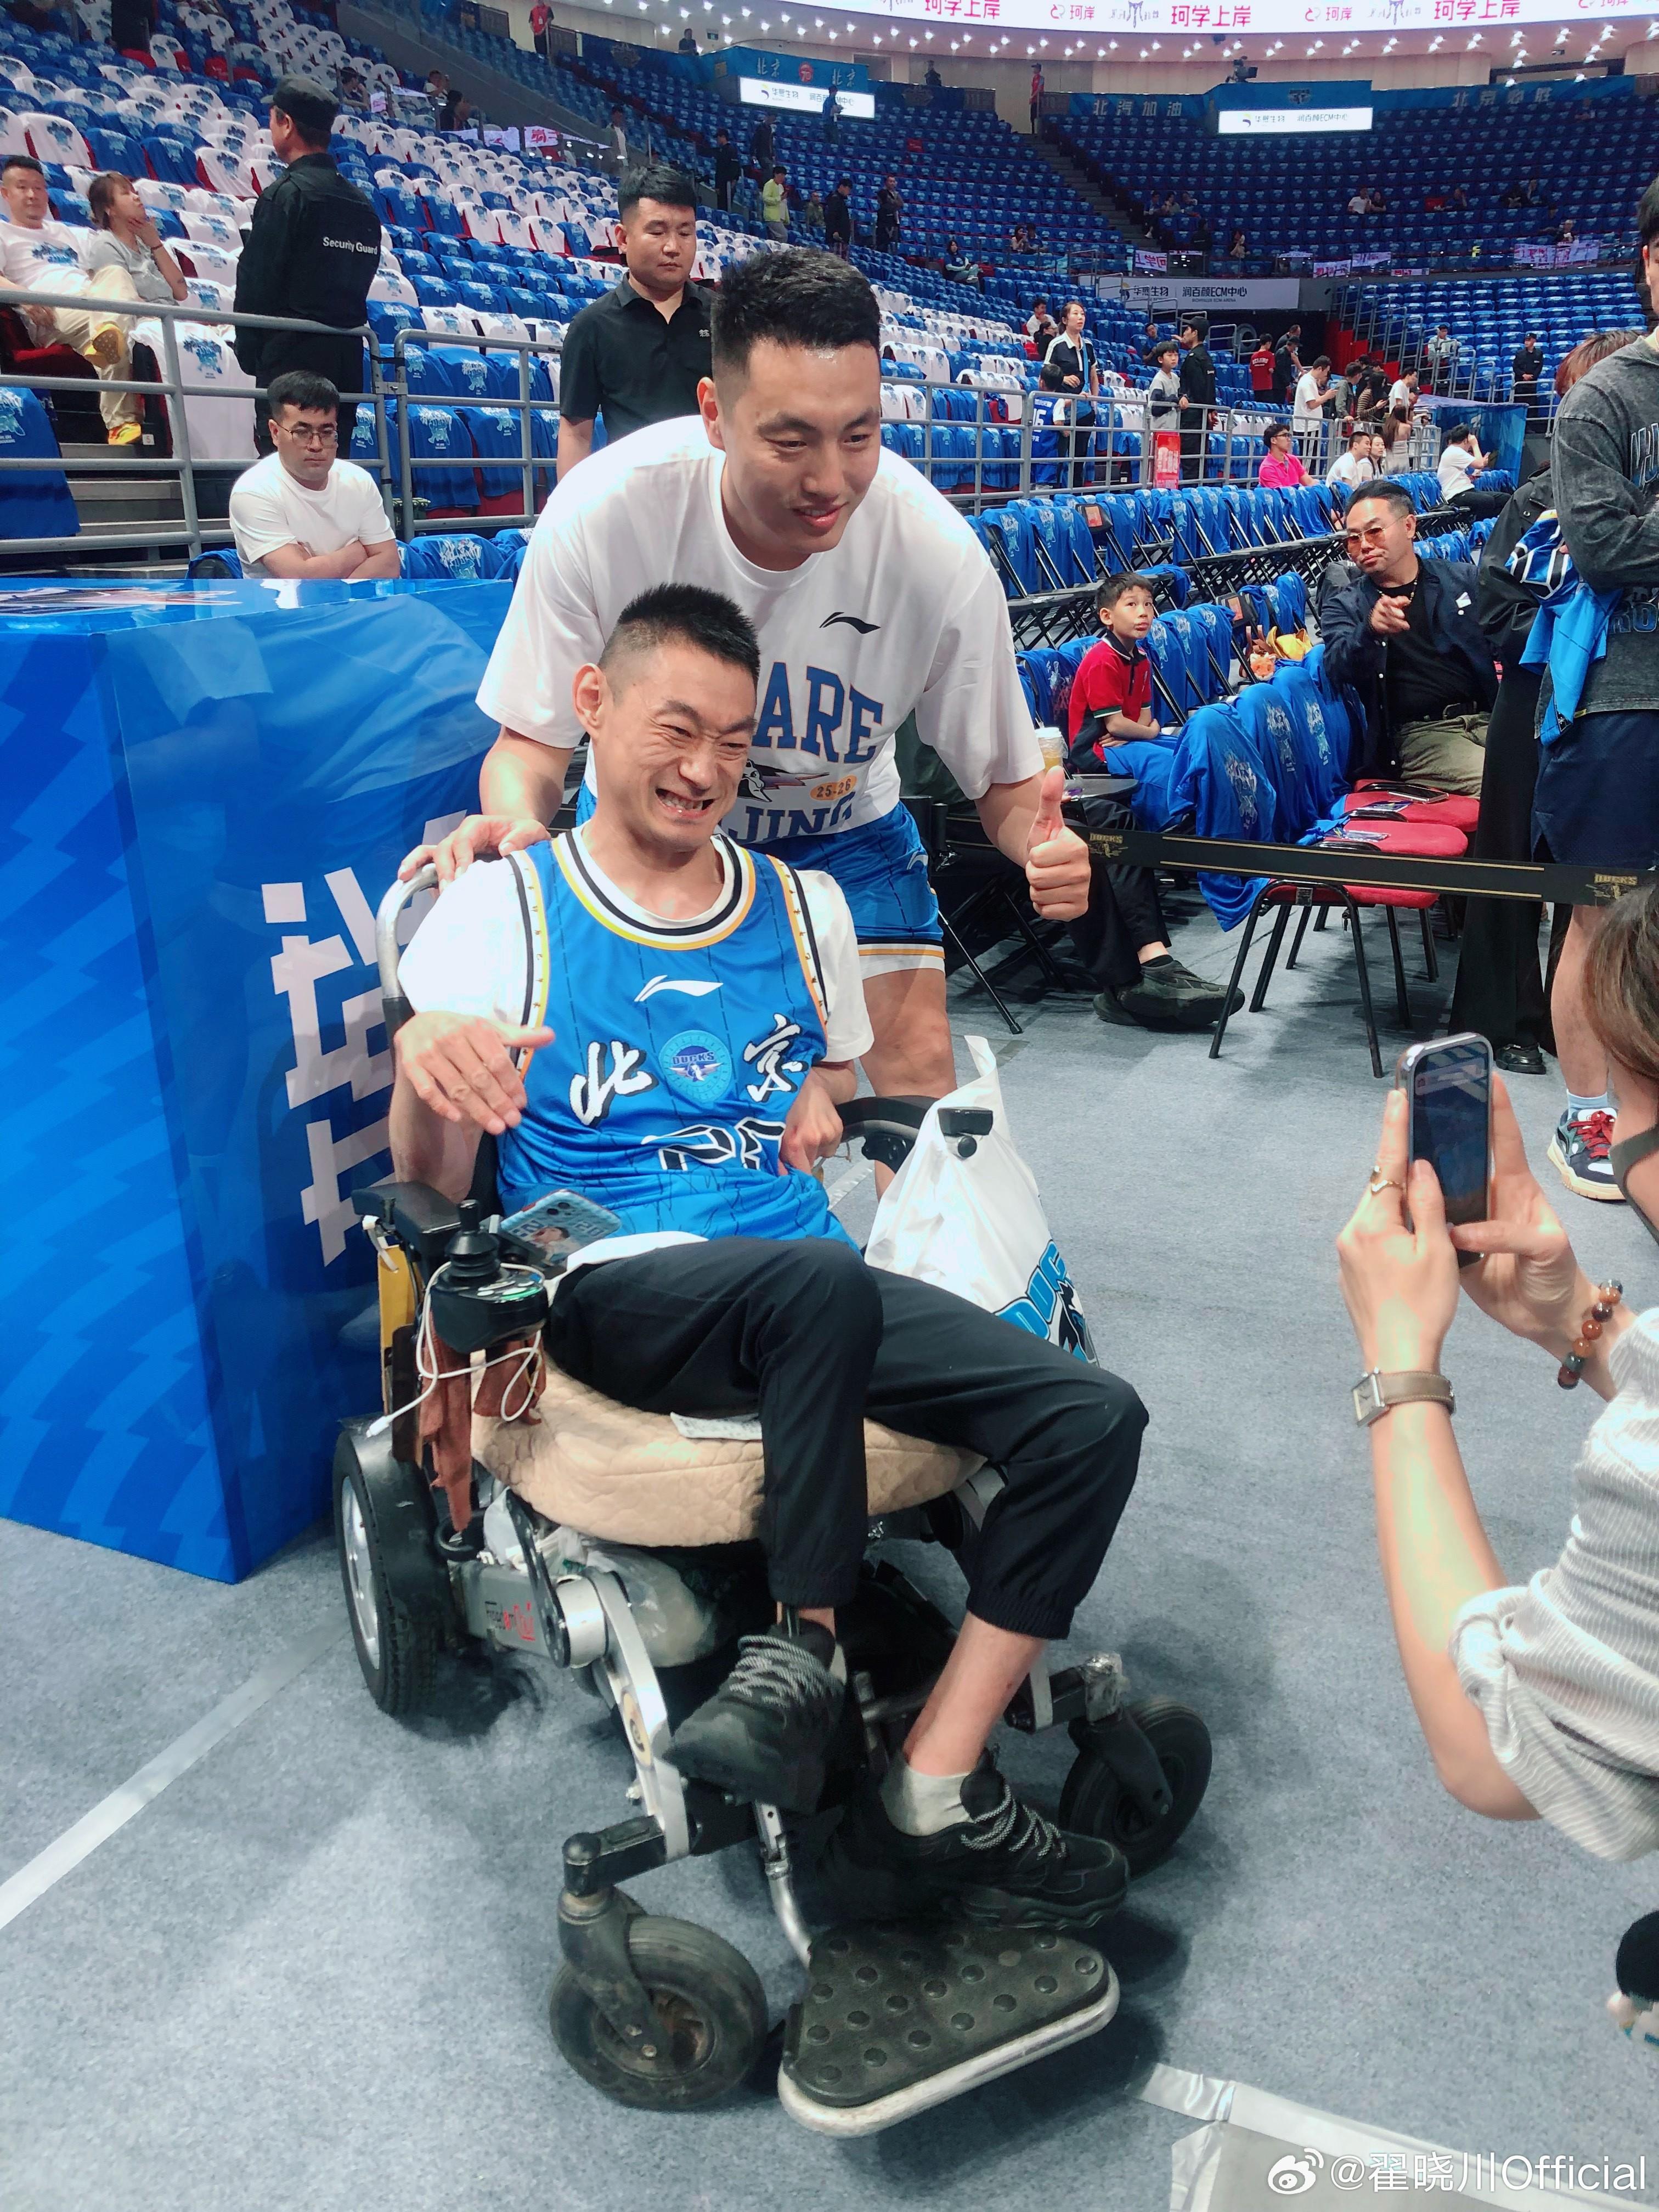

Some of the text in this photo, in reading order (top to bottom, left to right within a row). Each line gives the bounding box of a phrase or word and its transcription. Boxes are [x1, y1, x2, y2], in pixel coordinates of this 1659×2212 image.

[1171, 5, 1251, 27] 珂学上岸
[1092, 99, 1182, 117] 北汽加油
[323, 236, 377, 255] Security Guard
[751, 662, 884, 764] ARE
[816, 778, 852, 798] 25-26
[720, 791, 856, 844] JING
[1594, 873, 1638, 886] DUCKS
[672, 1051, 715, 1066] DUCKS
